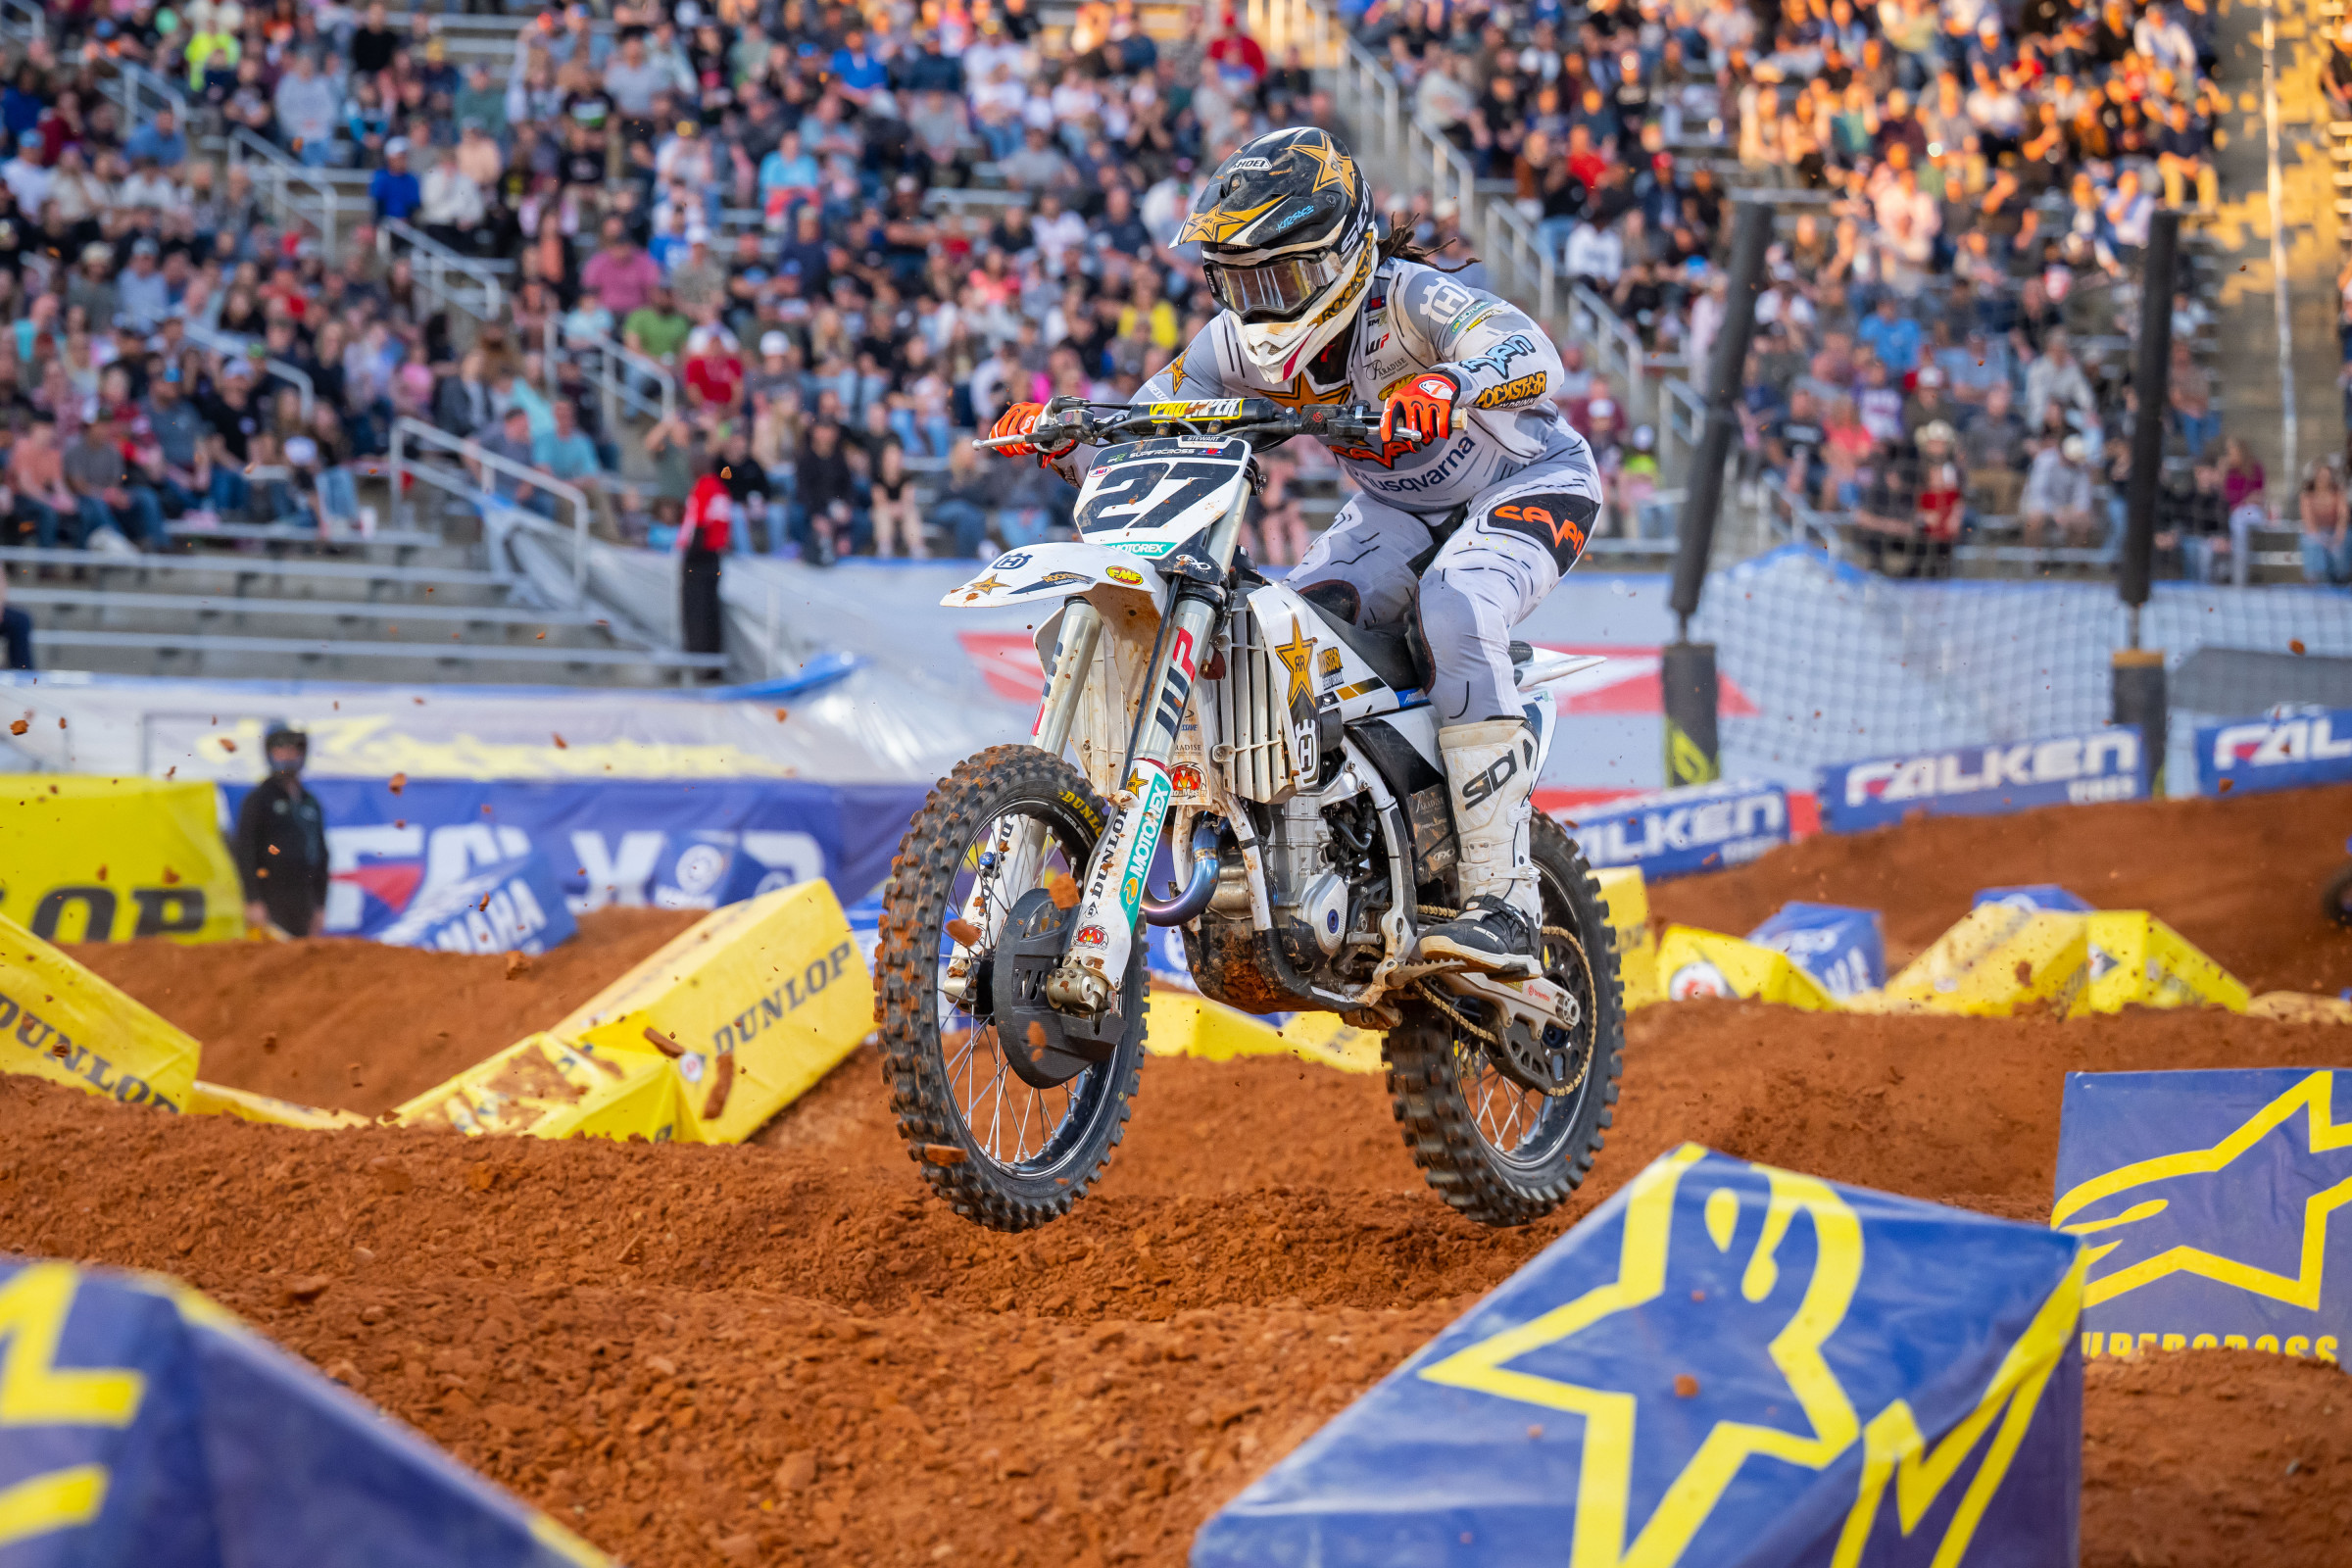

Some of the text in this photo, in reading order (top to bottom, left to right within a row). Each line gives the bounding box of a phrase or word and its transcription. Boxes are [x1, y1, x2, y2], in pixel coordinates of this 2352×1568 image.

[1129, 448, 1196, 459] SUPERCROSS
[1075, 462, 1241, 535] 27
[1108, 566, 1143, 584] FMF
[1110, 542, 1166, 555] MOTOREX
[1845, 729, 2138, 808] FALKEN
[1061, 790, 1105, 839] DUNLO
[1129, 785, 1169, 879] MOTOREX
[1575, 795, 1784, 865] ALKEN
[712, 940, 852, 1056] DUNLOP
